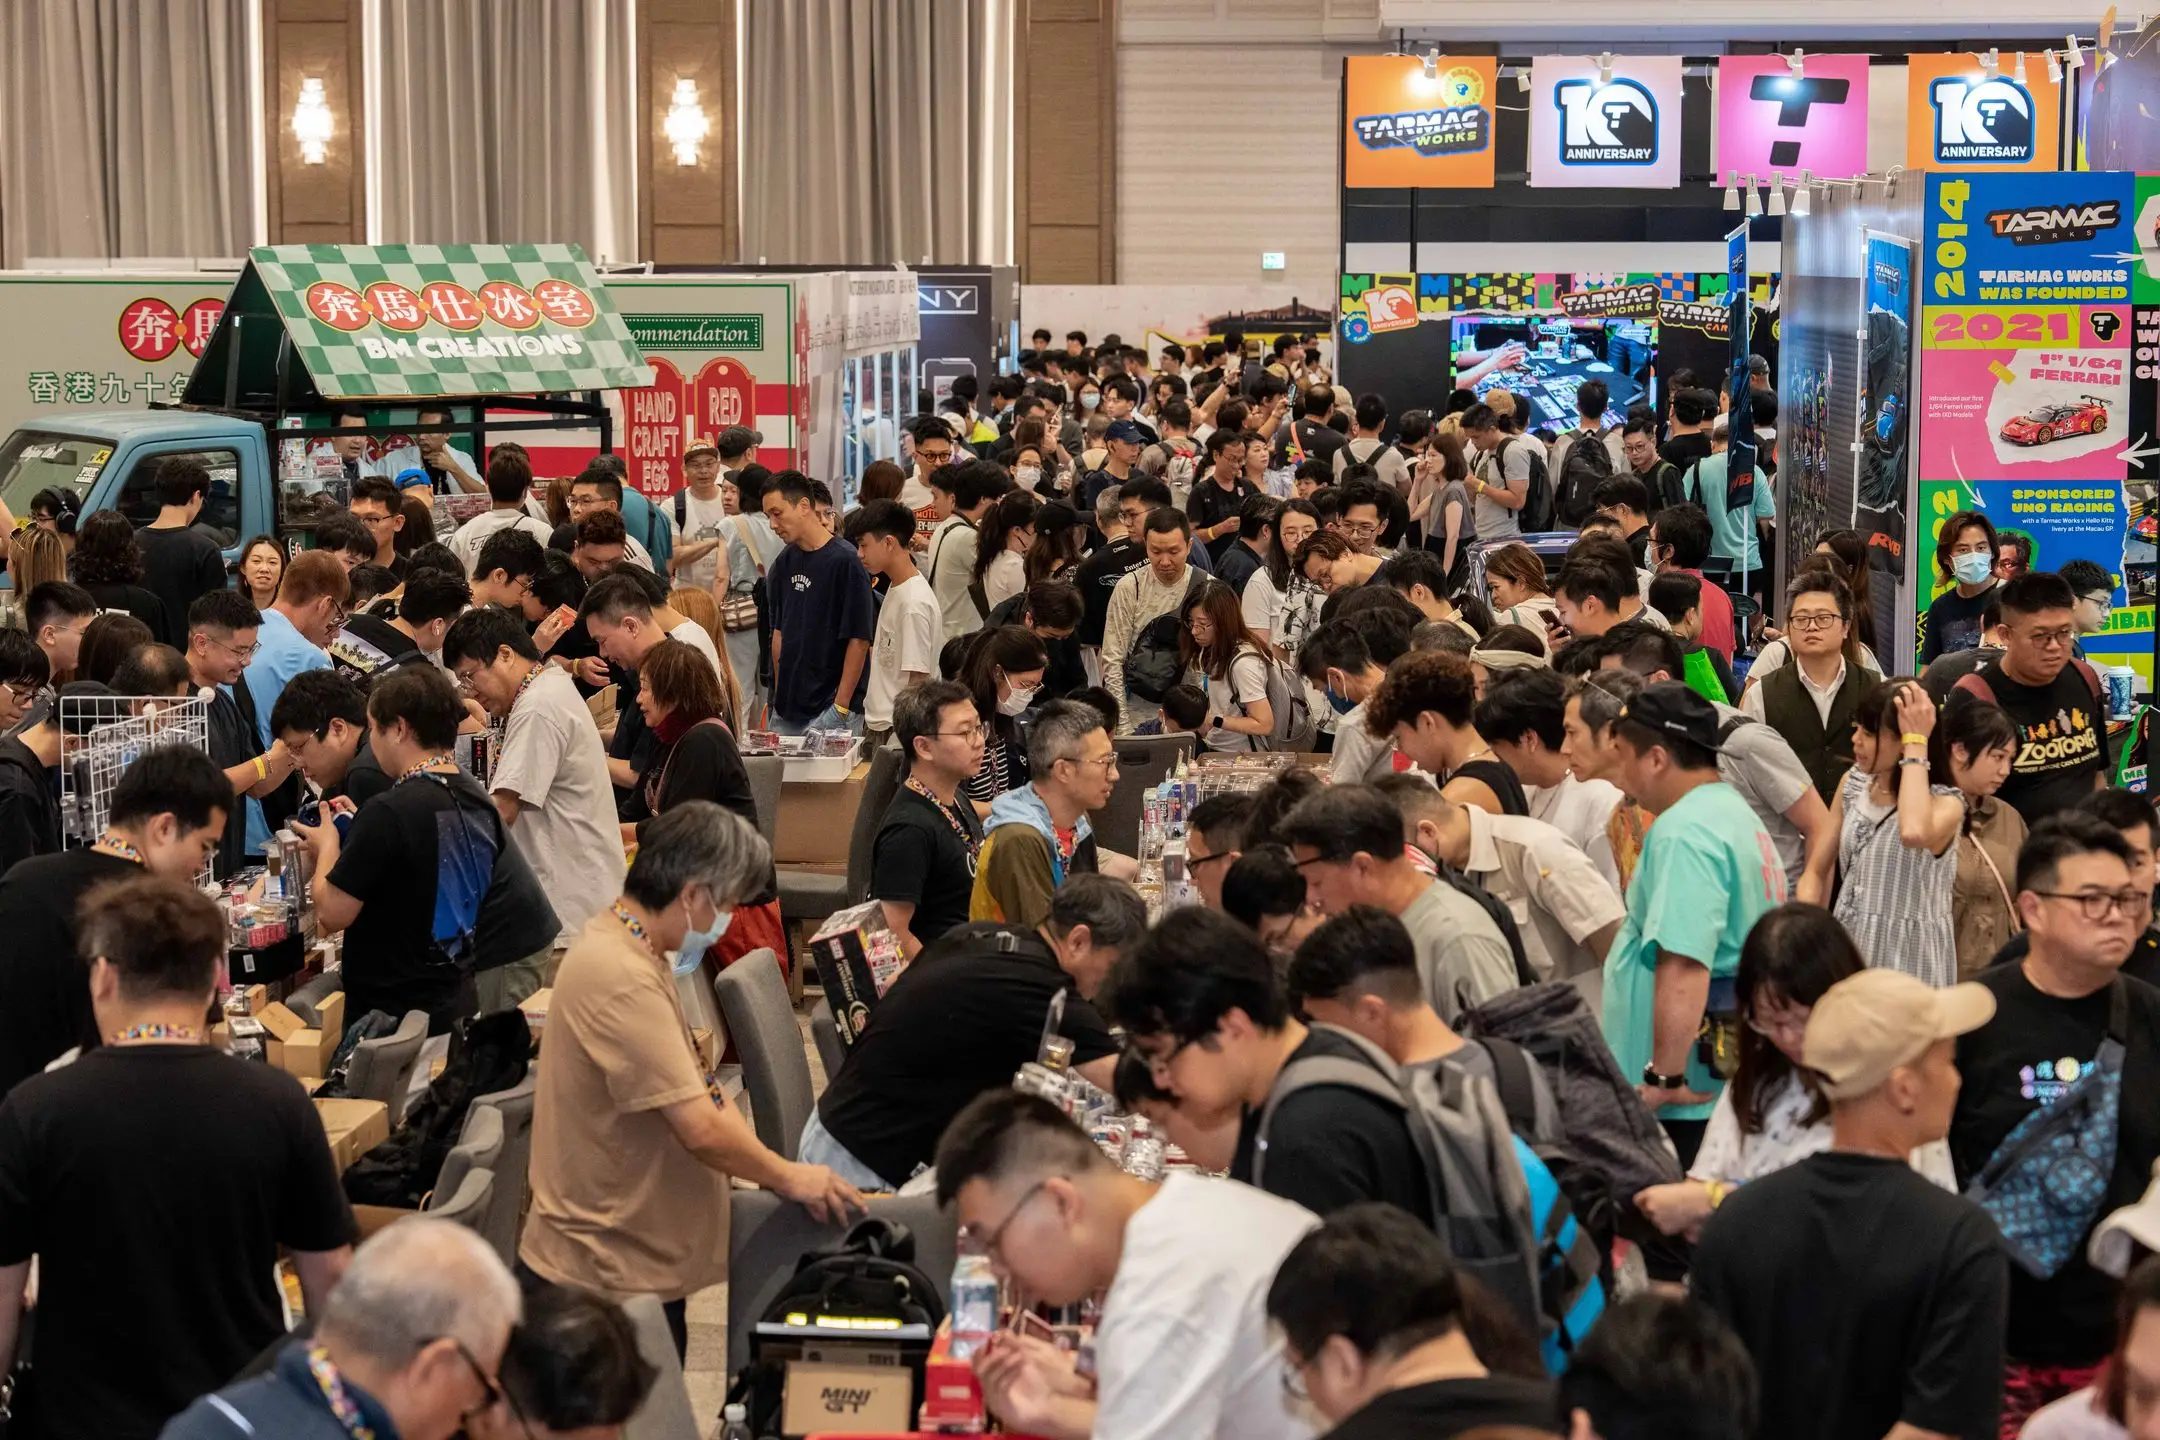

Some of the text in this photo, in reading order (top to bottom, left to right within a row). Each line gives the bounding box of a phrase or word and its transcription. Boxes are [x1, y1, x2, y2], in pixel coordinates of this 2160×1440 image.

[1359, 110, 1479, 140] TARMAC
[1416, 131, 1477, 146] WORKS
[1566, 148, 1652, 160] ANNIVERSARY
[1941, 146, 2028, 157] ANNIVERSARY
[1990, 205, 2116, 233] TARMAC
[1934, 179, 1970, 298] 2014
[2016, 229, 2092, 242] WORKS
[1979, 270, 2128, 283] TARMAC WORKS
[1563, 287, 1653, 312] TARMAC
[1979, 286, 2128, 299] WAS FOUNDED
[313, 286, 591, 323] 奔馬仕冰室
[1607, 304, 1652, 316] WORKS
[1933, 313, 2069, 342] 2021
[361, 333, 583, 360] BM CREATIONS
[2068, 354, 2122, 370] 1/64
[2030, 369, 2121, 386] FERRARI
[634, 392, 676, 423] HAND
[708, 387, 742, 425] RED
[632, 426, 679, 458] CRAFT
[642, 460, 669, 492] EG6
[2012, 489, 2115, 500] SPONSORED
[2011, 503, 2115, 513] UNO RACING
[2052, 525, 2067, 533] livery
[2101, 517, 2115, 525] Kitty
[1124, 561, 1142, 572] Enter
[821, 1387, 871, 1405] MINI
[825, 1402, 860, 1414] GT
